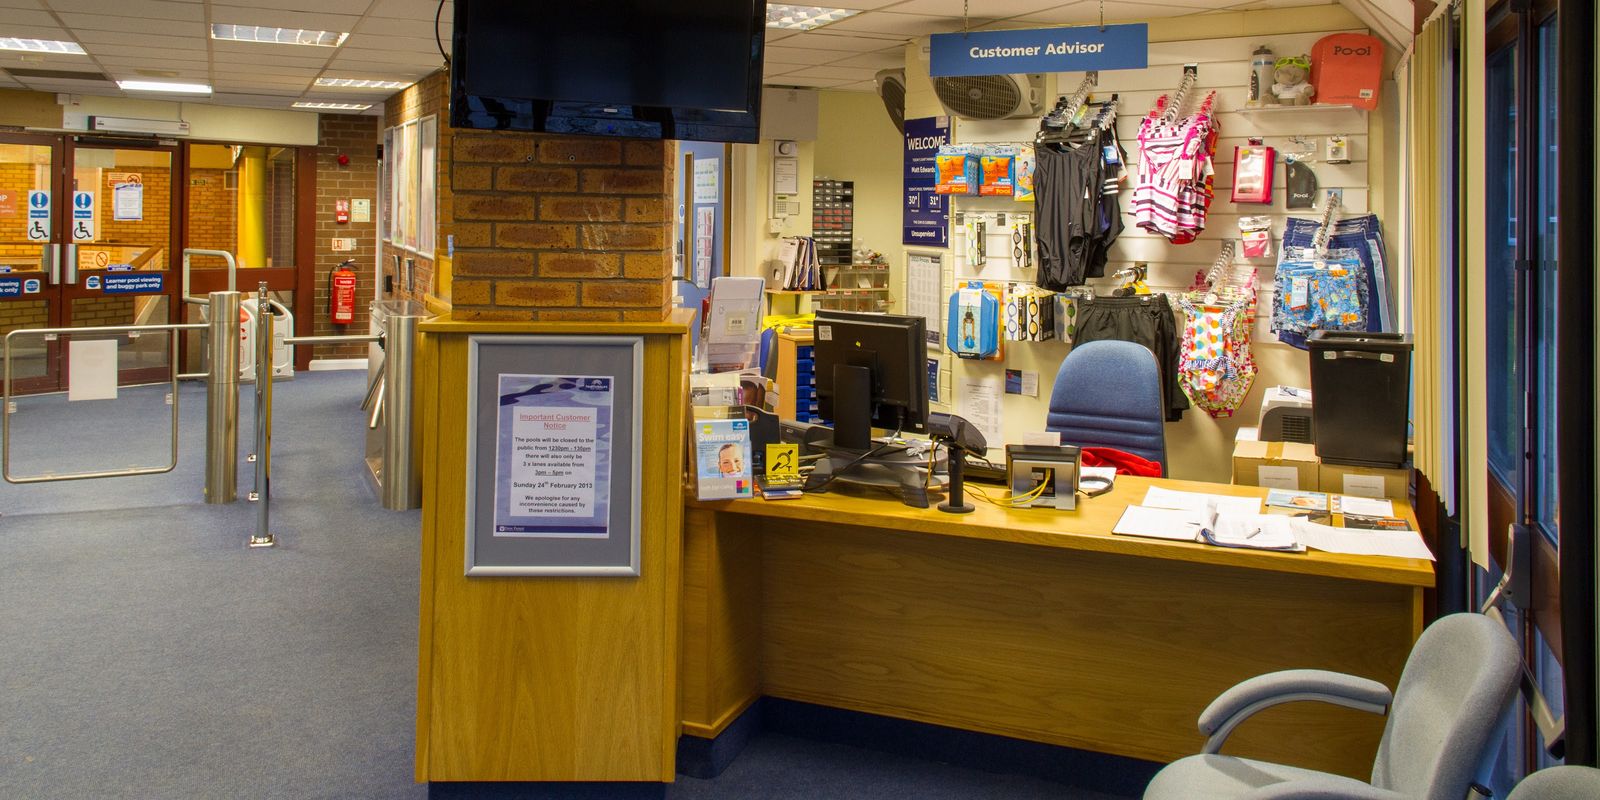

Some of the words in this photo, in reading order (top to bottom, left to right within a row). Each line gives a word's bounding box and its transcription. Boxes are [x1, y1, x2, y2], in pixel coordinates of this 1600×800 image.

[970, 45, 1040, 58] Customer
[1045, 42, 1104, 55] Advisor
[907, 136, 946, 151] WELCOME
[911, 230, 936, 238] Unsupervised
[520, 413, 554, 421] Important
[556, 413, 591, 422] Customer
[543, 422, 566, 430] Notice
[699, 432, 725, 441] Swim
[725, 433, 746, 442] easy
[513, 481, 537, 489] Sunday
[550, 482, 577, 490] February
